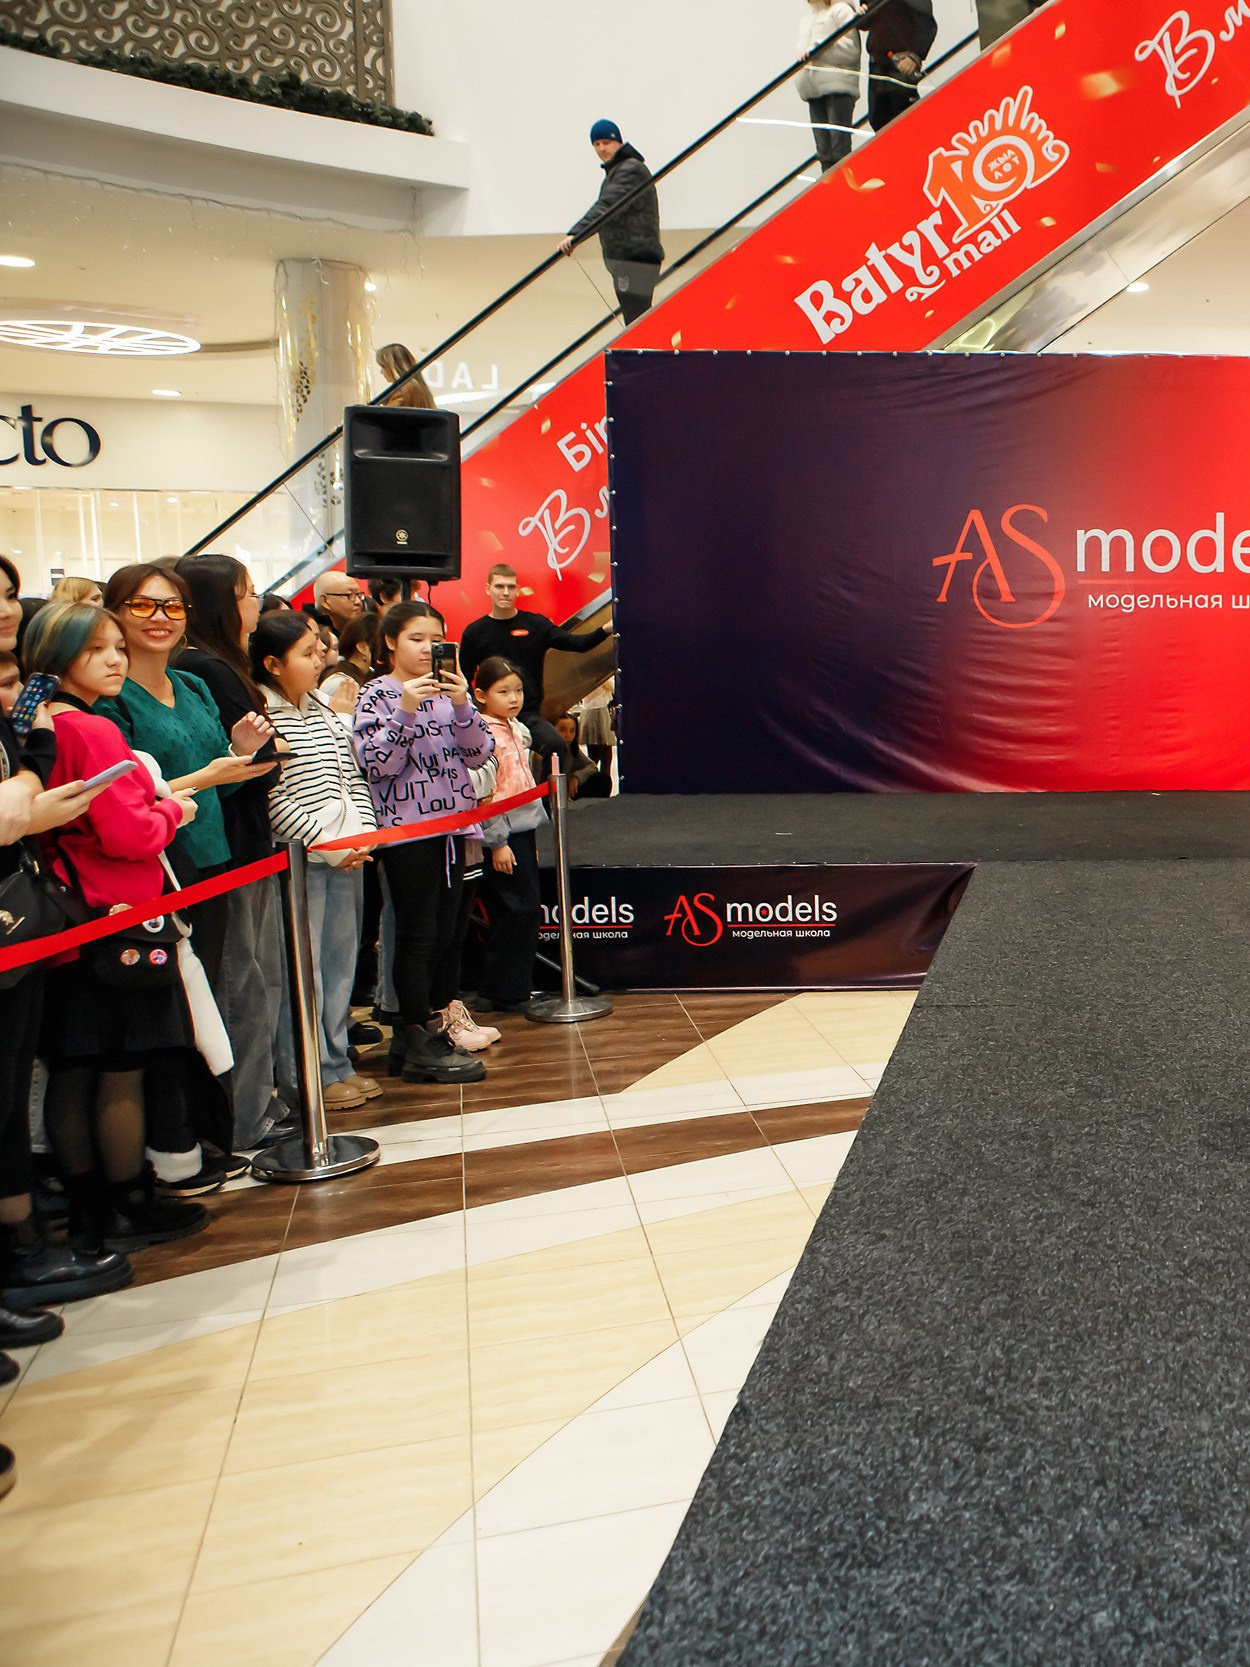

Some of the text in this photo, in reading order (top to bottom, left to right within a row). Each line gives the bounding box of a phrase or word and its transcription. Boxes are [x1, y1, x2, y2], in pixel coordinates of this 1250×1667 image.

[943, 209, 1021, 278] mall
[794, 211, 950, 345] Batyr
[932, 503, 1067, 629] AS
[1087, 593, 1223, 613] модельная
[541, 896, 635, 924] dels
[664, 892, 838, 946] AS models
[593, 931, 629, 939] школа
[732, 930, 831, 940] модельная школа
